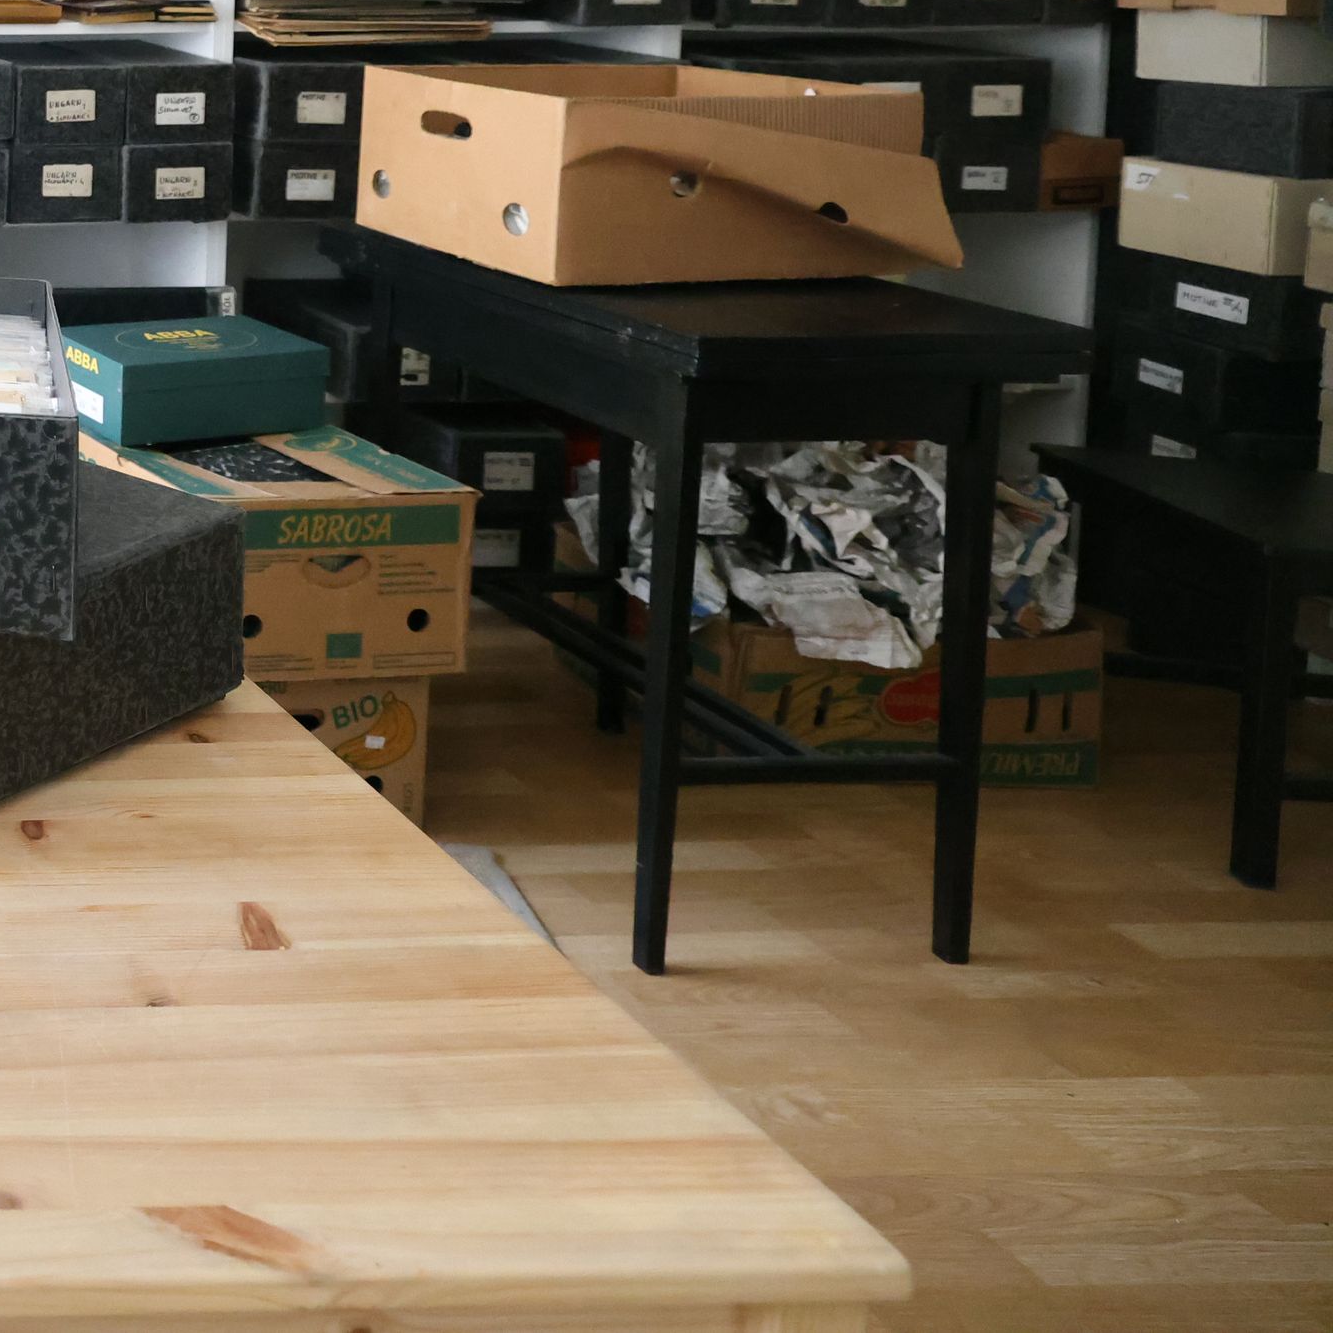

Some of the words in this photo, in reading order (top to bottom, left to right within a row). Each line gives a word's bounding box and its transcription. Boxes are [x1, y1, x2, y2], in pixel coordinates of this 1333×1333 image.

[144, 329, 217, 341] ABBA
[65, 345, 100, 375] ABBA
[277, 513, 394, 545] SABROSA
[332, 693, 380, 729] BIO
